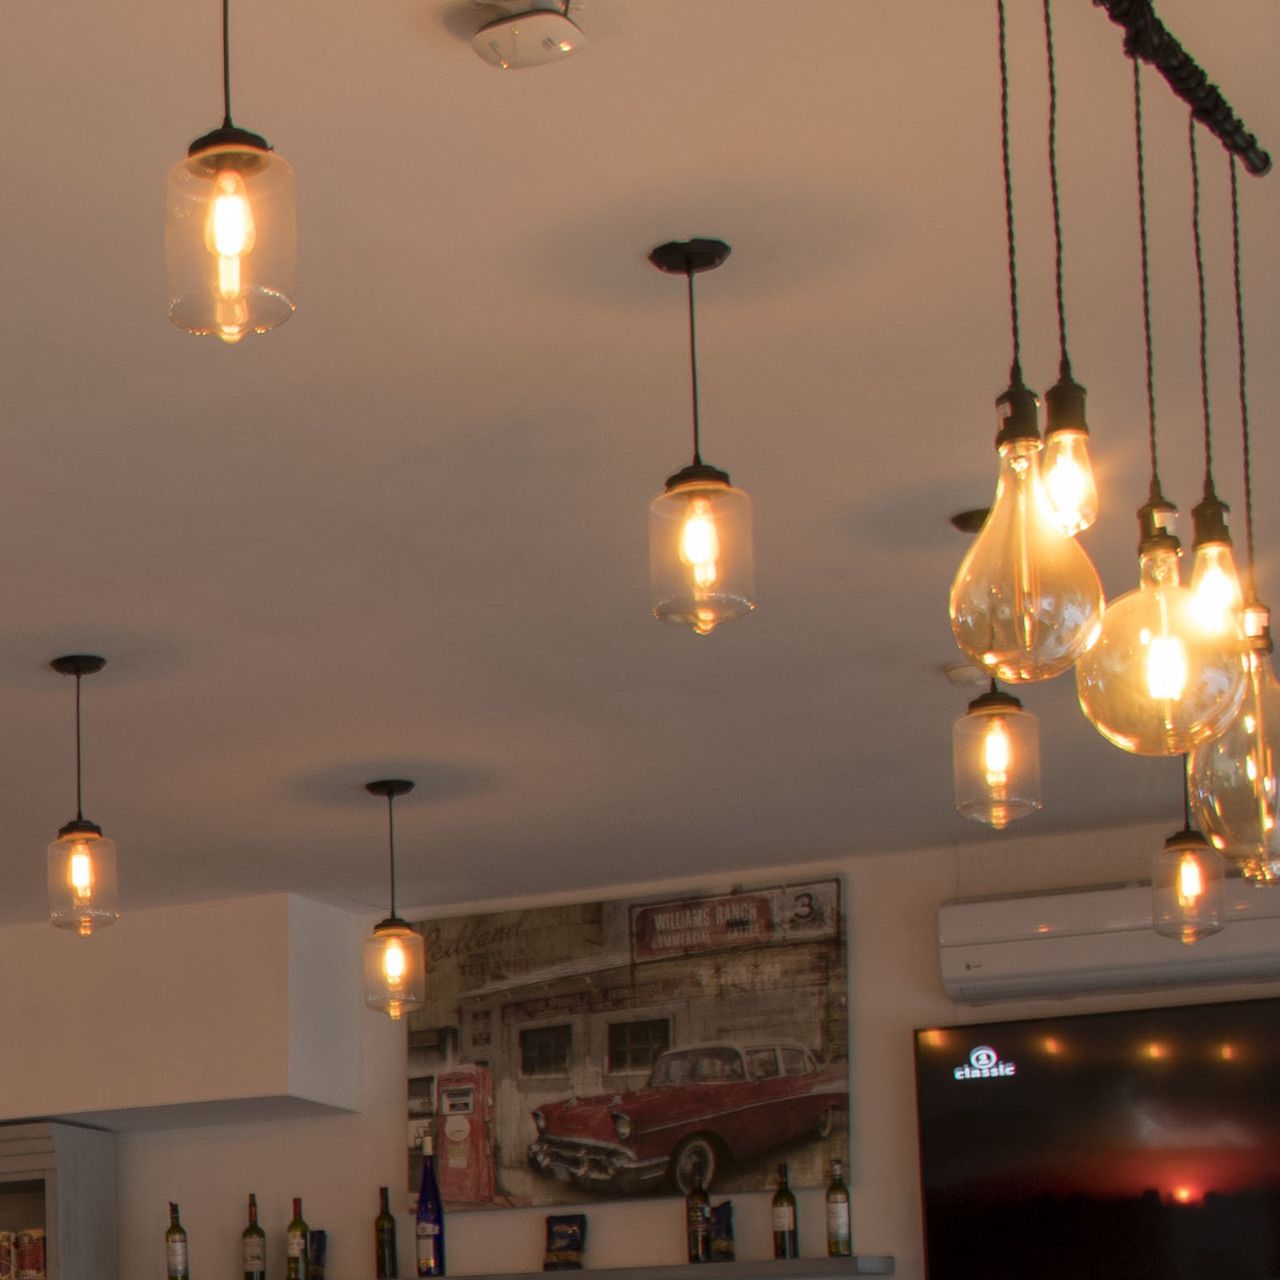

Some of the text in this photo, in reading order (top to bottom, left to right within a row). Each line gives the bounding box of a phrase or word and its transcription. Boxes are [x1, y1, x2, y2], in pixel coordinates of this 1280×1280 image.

[654, 906, 712, 931] WILLIAMS
[793, 892, 814, 920] 3
[953, 1061, 1017, 1080] classic
